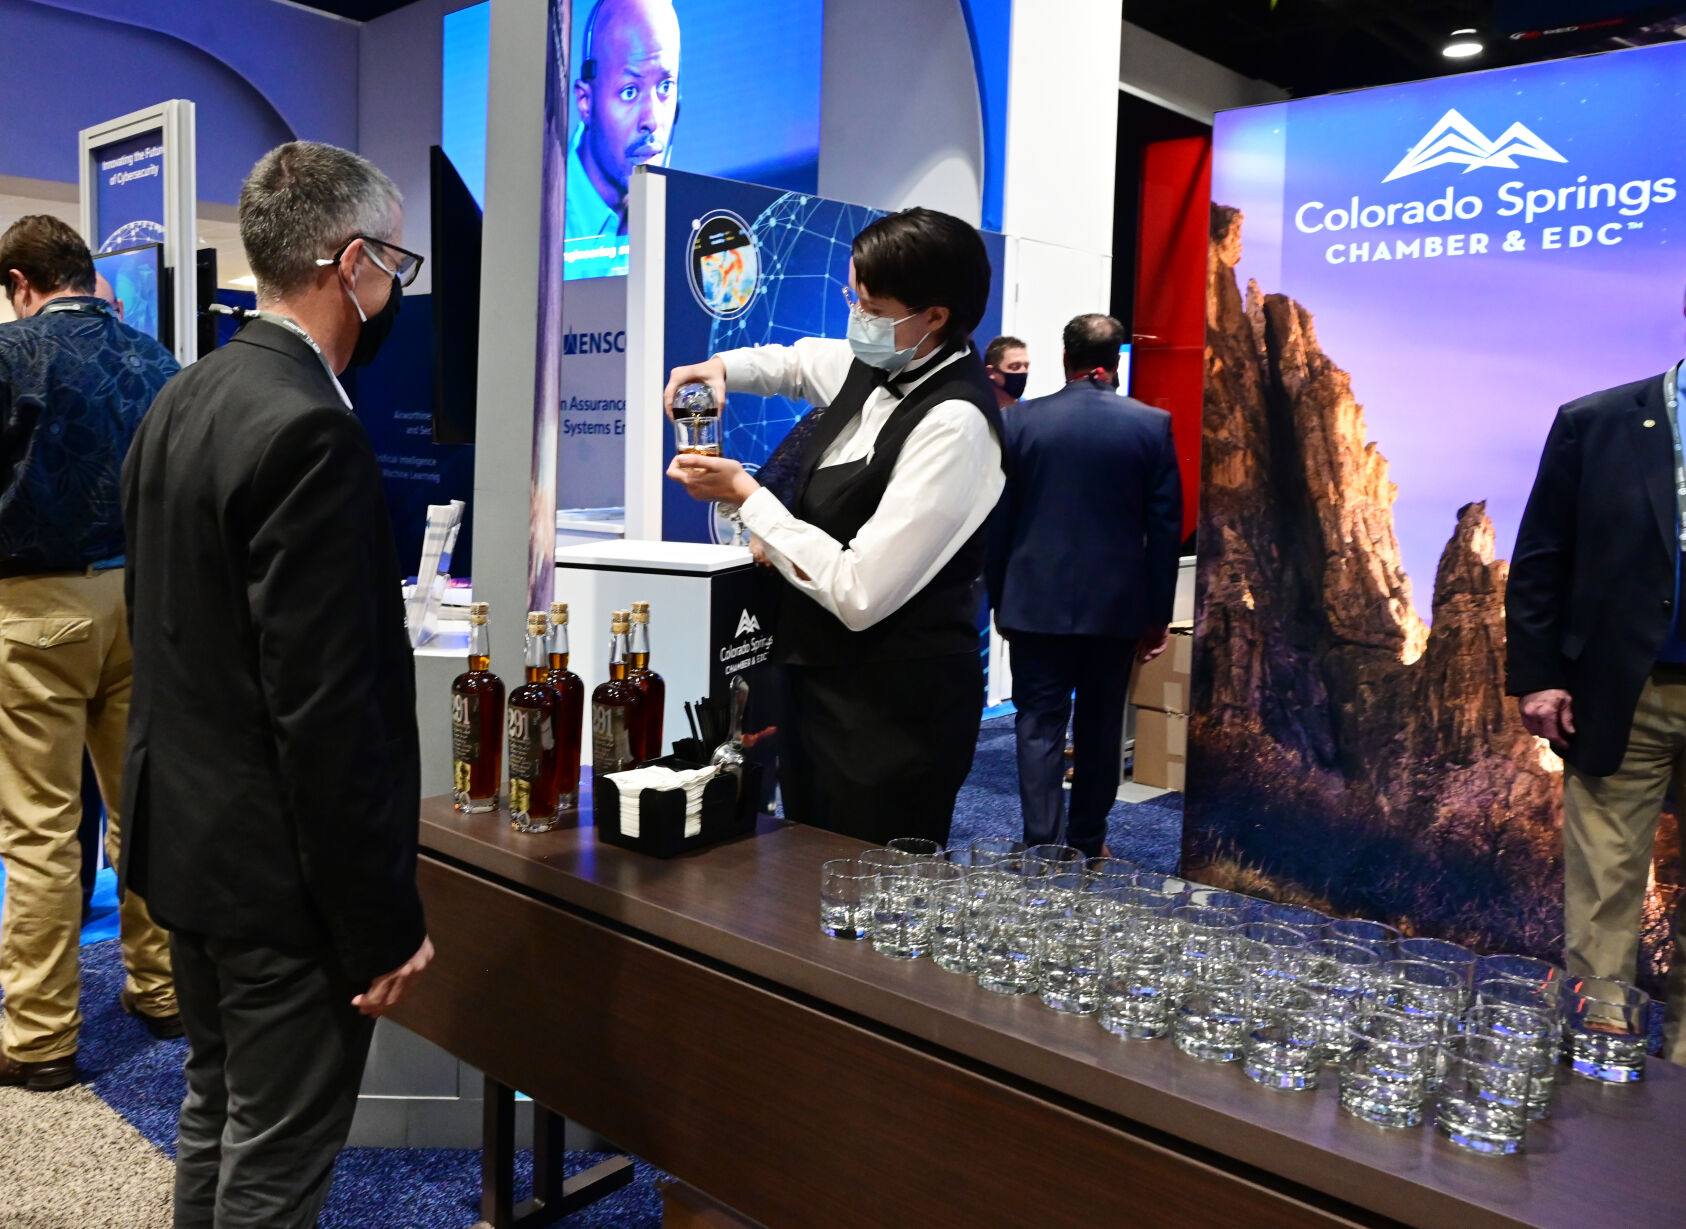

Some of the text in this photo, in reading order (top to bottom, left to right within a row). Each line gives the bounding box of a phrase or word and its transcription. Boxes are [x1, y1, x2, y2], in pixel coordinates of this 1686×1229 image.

[134, 151, 144, 161] the
[144, 146, 164, 159] Futur
[1294, 175, 1677, 233] Colorado Springs
[1325, 233, 1489, 265] CHAMBER
[1502, 229, 1526, 252] &
[579, 330, 626, 355] ENSC
[563, 419, 611, 437] Systems
[720, 640, 750, 662] Colorado
